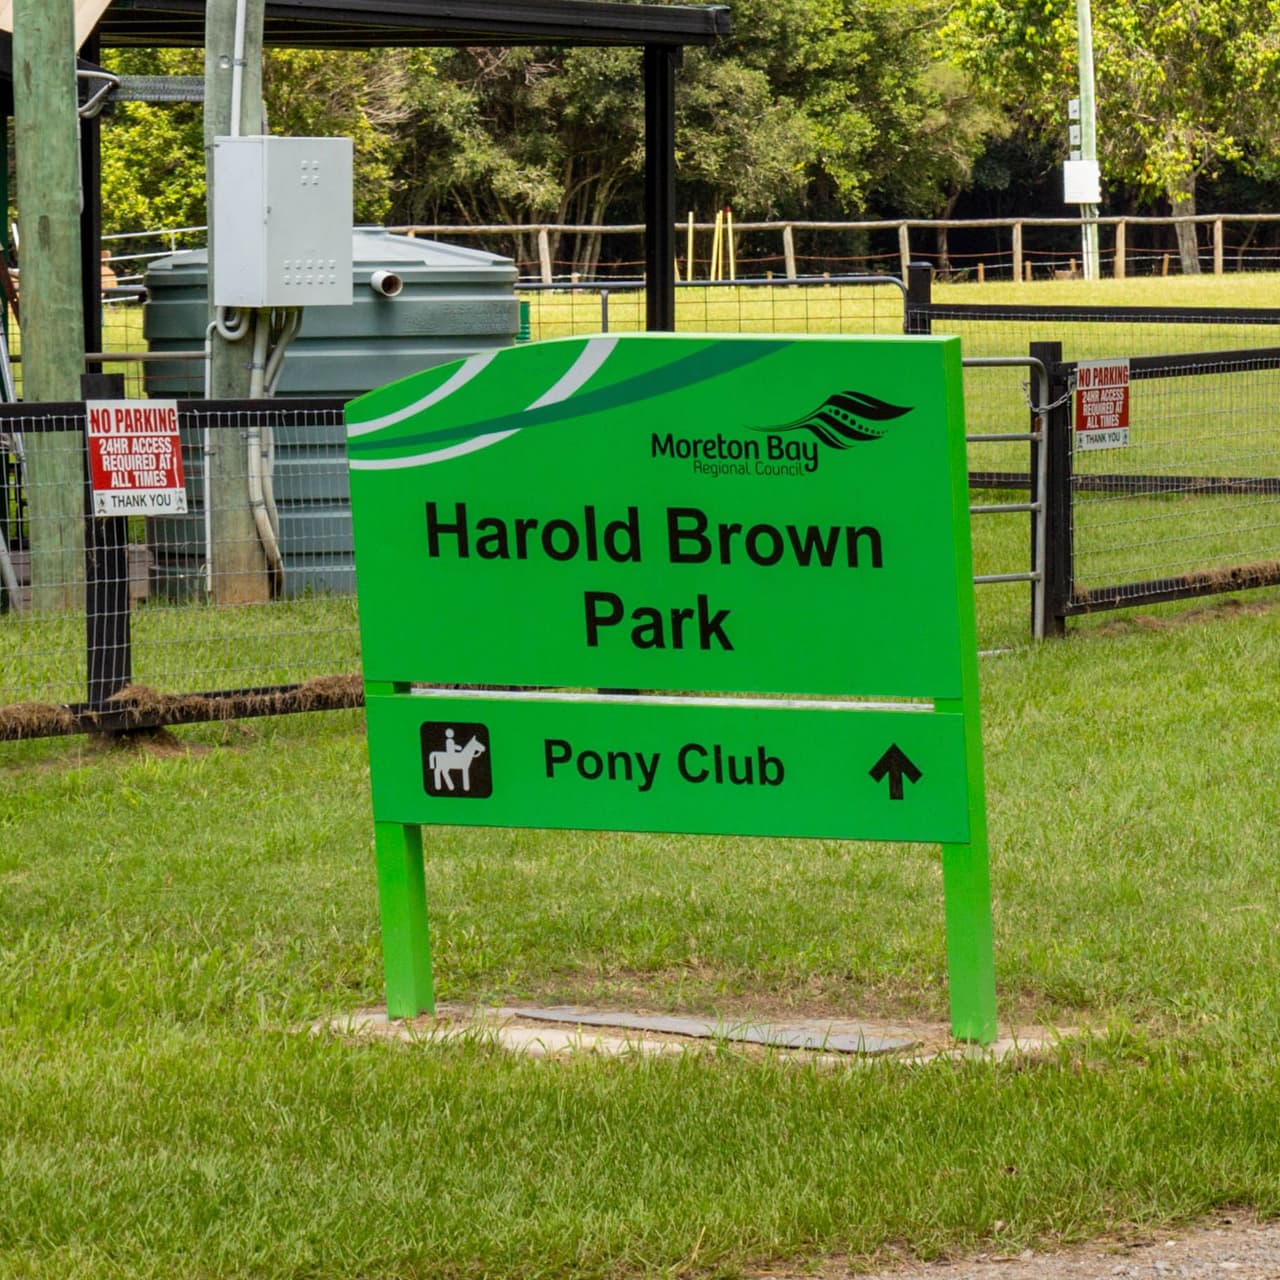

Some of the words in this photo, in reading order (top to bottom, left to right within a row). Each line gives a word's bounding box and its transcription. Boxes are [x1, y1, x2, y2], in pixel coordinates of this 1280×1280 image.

[1079, 368, 1090, 387] NO
[1093, 366, 1128, 386] PARKING
[1082, 391, 1099, 403] 24HR
[1101, 389, 1124, 402] ACCESS
[1083, 402, 1114, 416] REQUIRED
[1115, 401, 1123, 413] AT
[90, 409, 111, 433] NO
[115, 408, 176, 432] PARKING
[1087, 416, 1098, 428] ALL
[1101, 414, 1119, 427] TIMES
[100, 438, 129, 455] 24HR
[132, 437, 172, 453] ACCESS
[1086, 433, 1105, 443] THANK
[1106, 432, 1119, 441] YOU
[651, 433, 759, 460] Moreton
[767, 436, 818, 472] Bay
[102, 455, 156, 471] REQUIRED
[159, 455, 171, 469] AT
[693, 460, 750, 478] Regional
[755, 460, 804, 477] Council
[111, 472, 131, 488] ALL
[133, 471, 167, 487] TIMES
[111, 495, 147, 507] THANK
[148, 494, 171, 506] YOU
[425, 502, 641, 562] Harold
[666, 507, 883, 568] Brown
[584, 591, 734, 651] Park
[544, 739, 660, 792] Pony
[678, 743, 785, 786] Club
